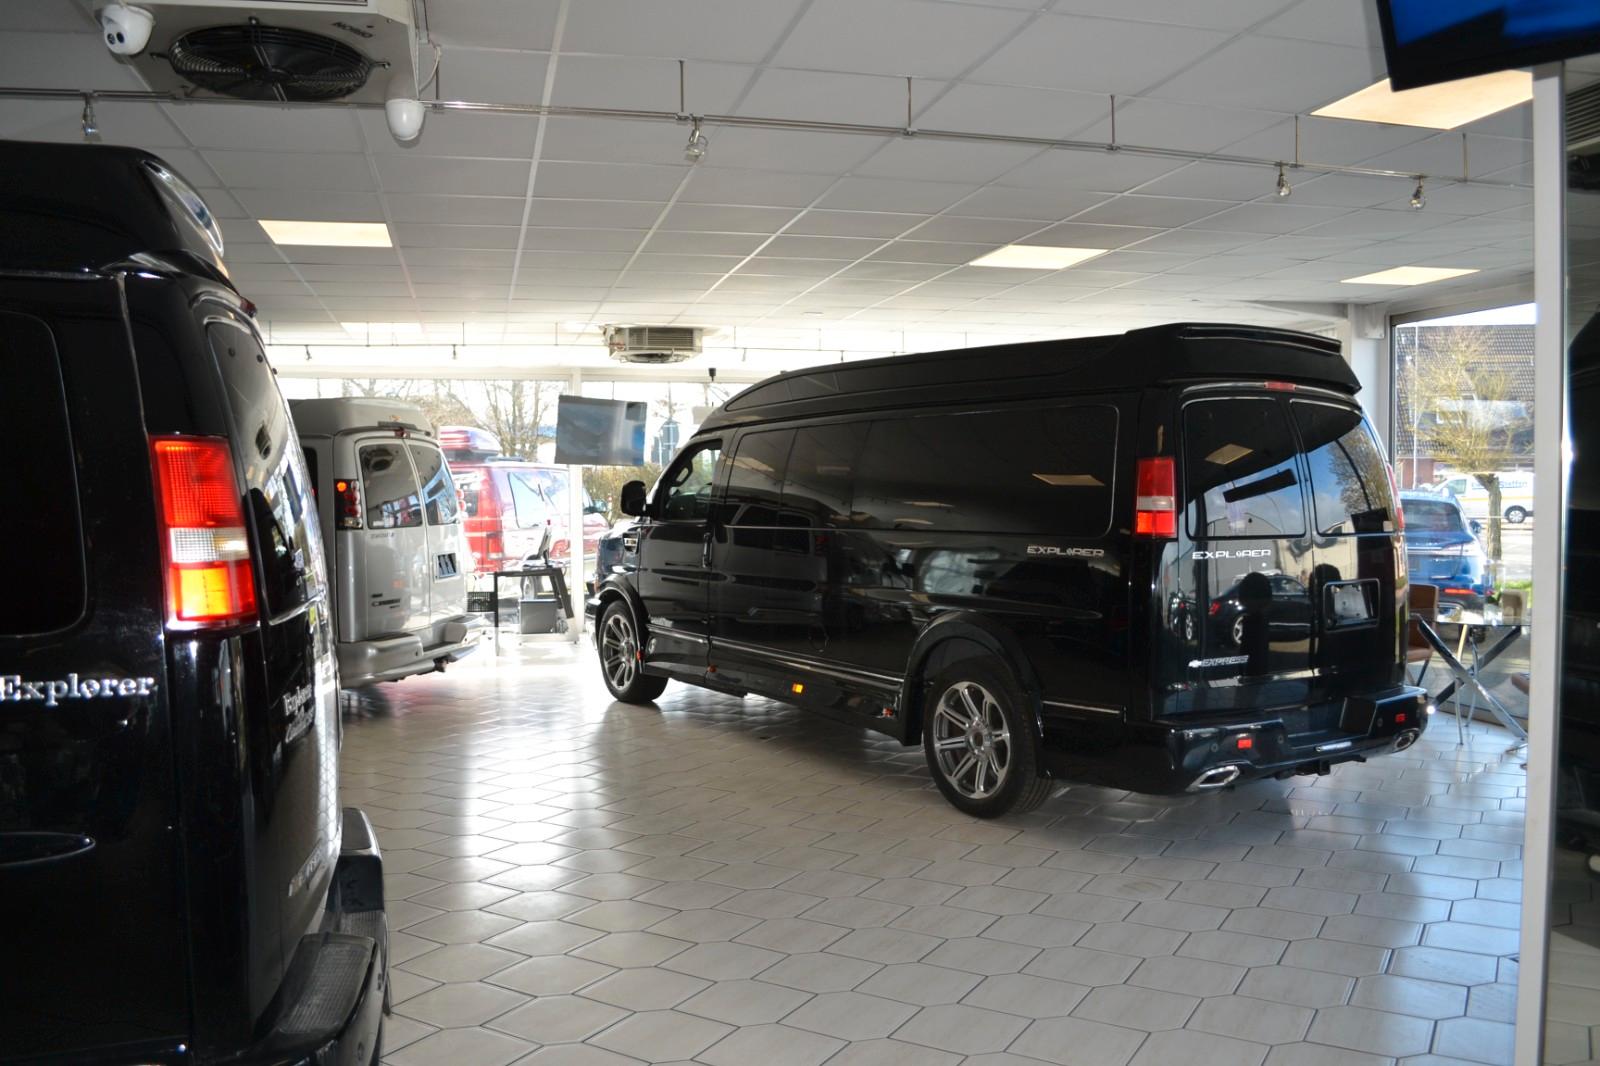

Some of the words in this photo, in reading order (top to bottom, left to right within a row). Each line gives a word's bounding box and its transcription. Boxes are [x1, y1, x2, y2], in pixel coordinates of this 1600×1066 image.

[1026, 545, 1105, 557] EXPLORER
[1191, 549, 1272, 560] EXPLORER
[1201, 654, 1250, 668] EXPRESS
[0, 673, 155, 706] Explorer
